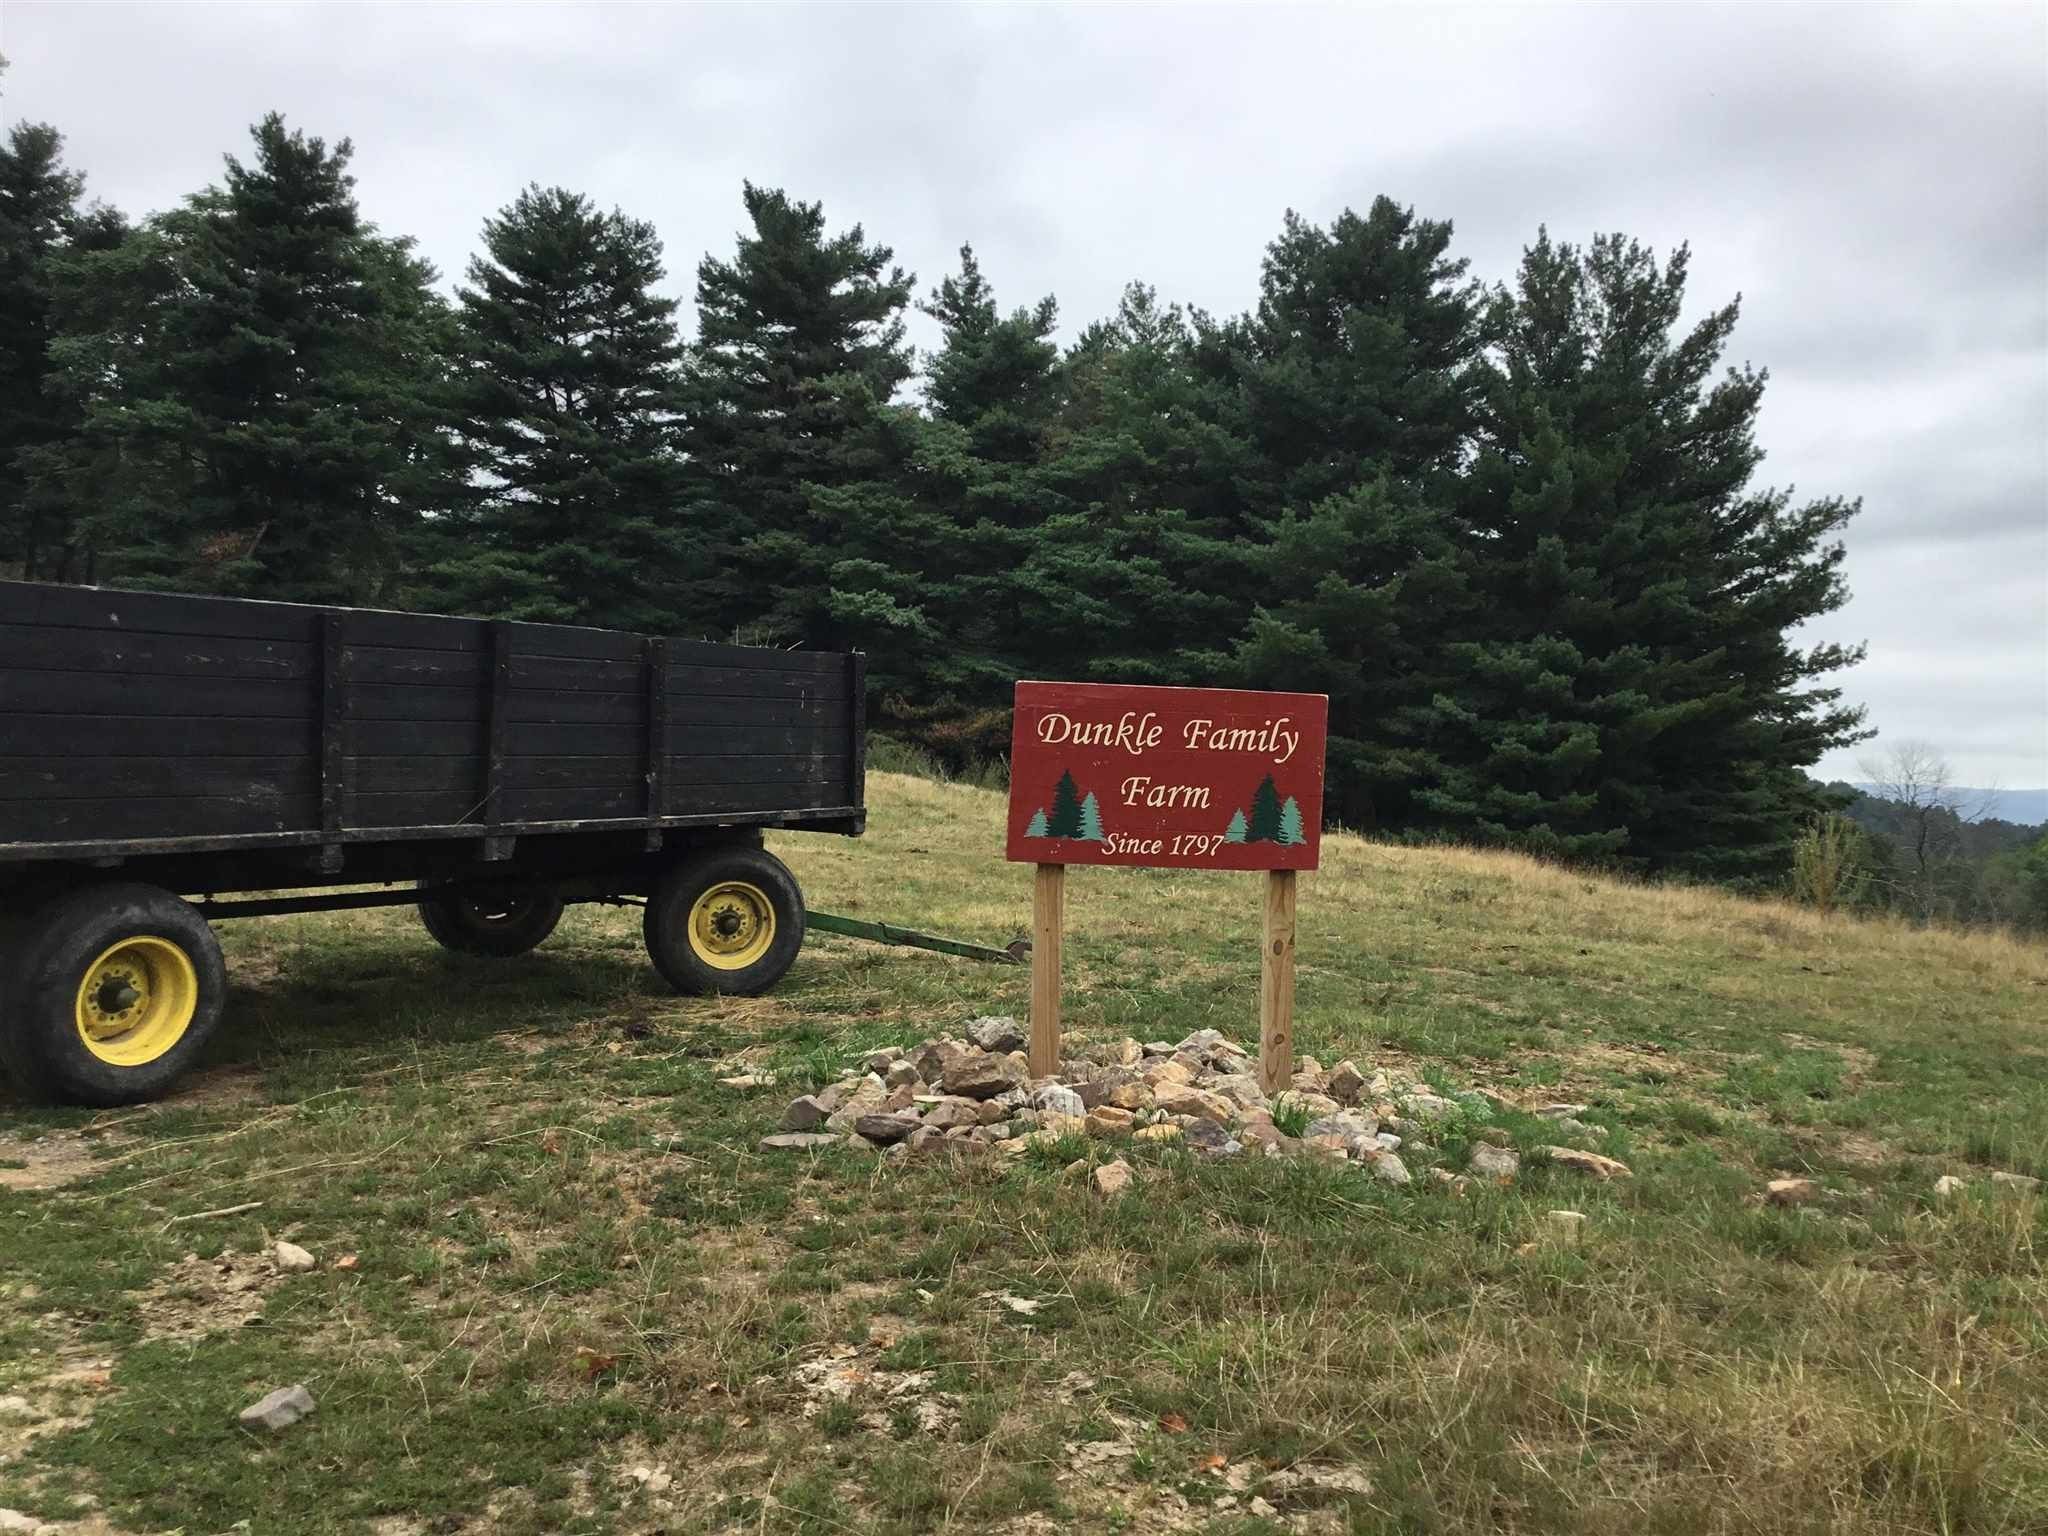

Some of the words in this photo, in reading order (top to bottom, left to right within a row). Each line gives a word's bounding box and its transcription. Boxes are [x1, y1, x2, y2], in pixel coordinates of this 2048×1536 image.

[1037, 711, 1163, 755] Dunkle
[1183, 717, 1299, 763] Family
[1120, 776, 1210, 809] Farm
[1101, 832, 1163, 855] Since
[1169, 834, 1225, 857] 1797
